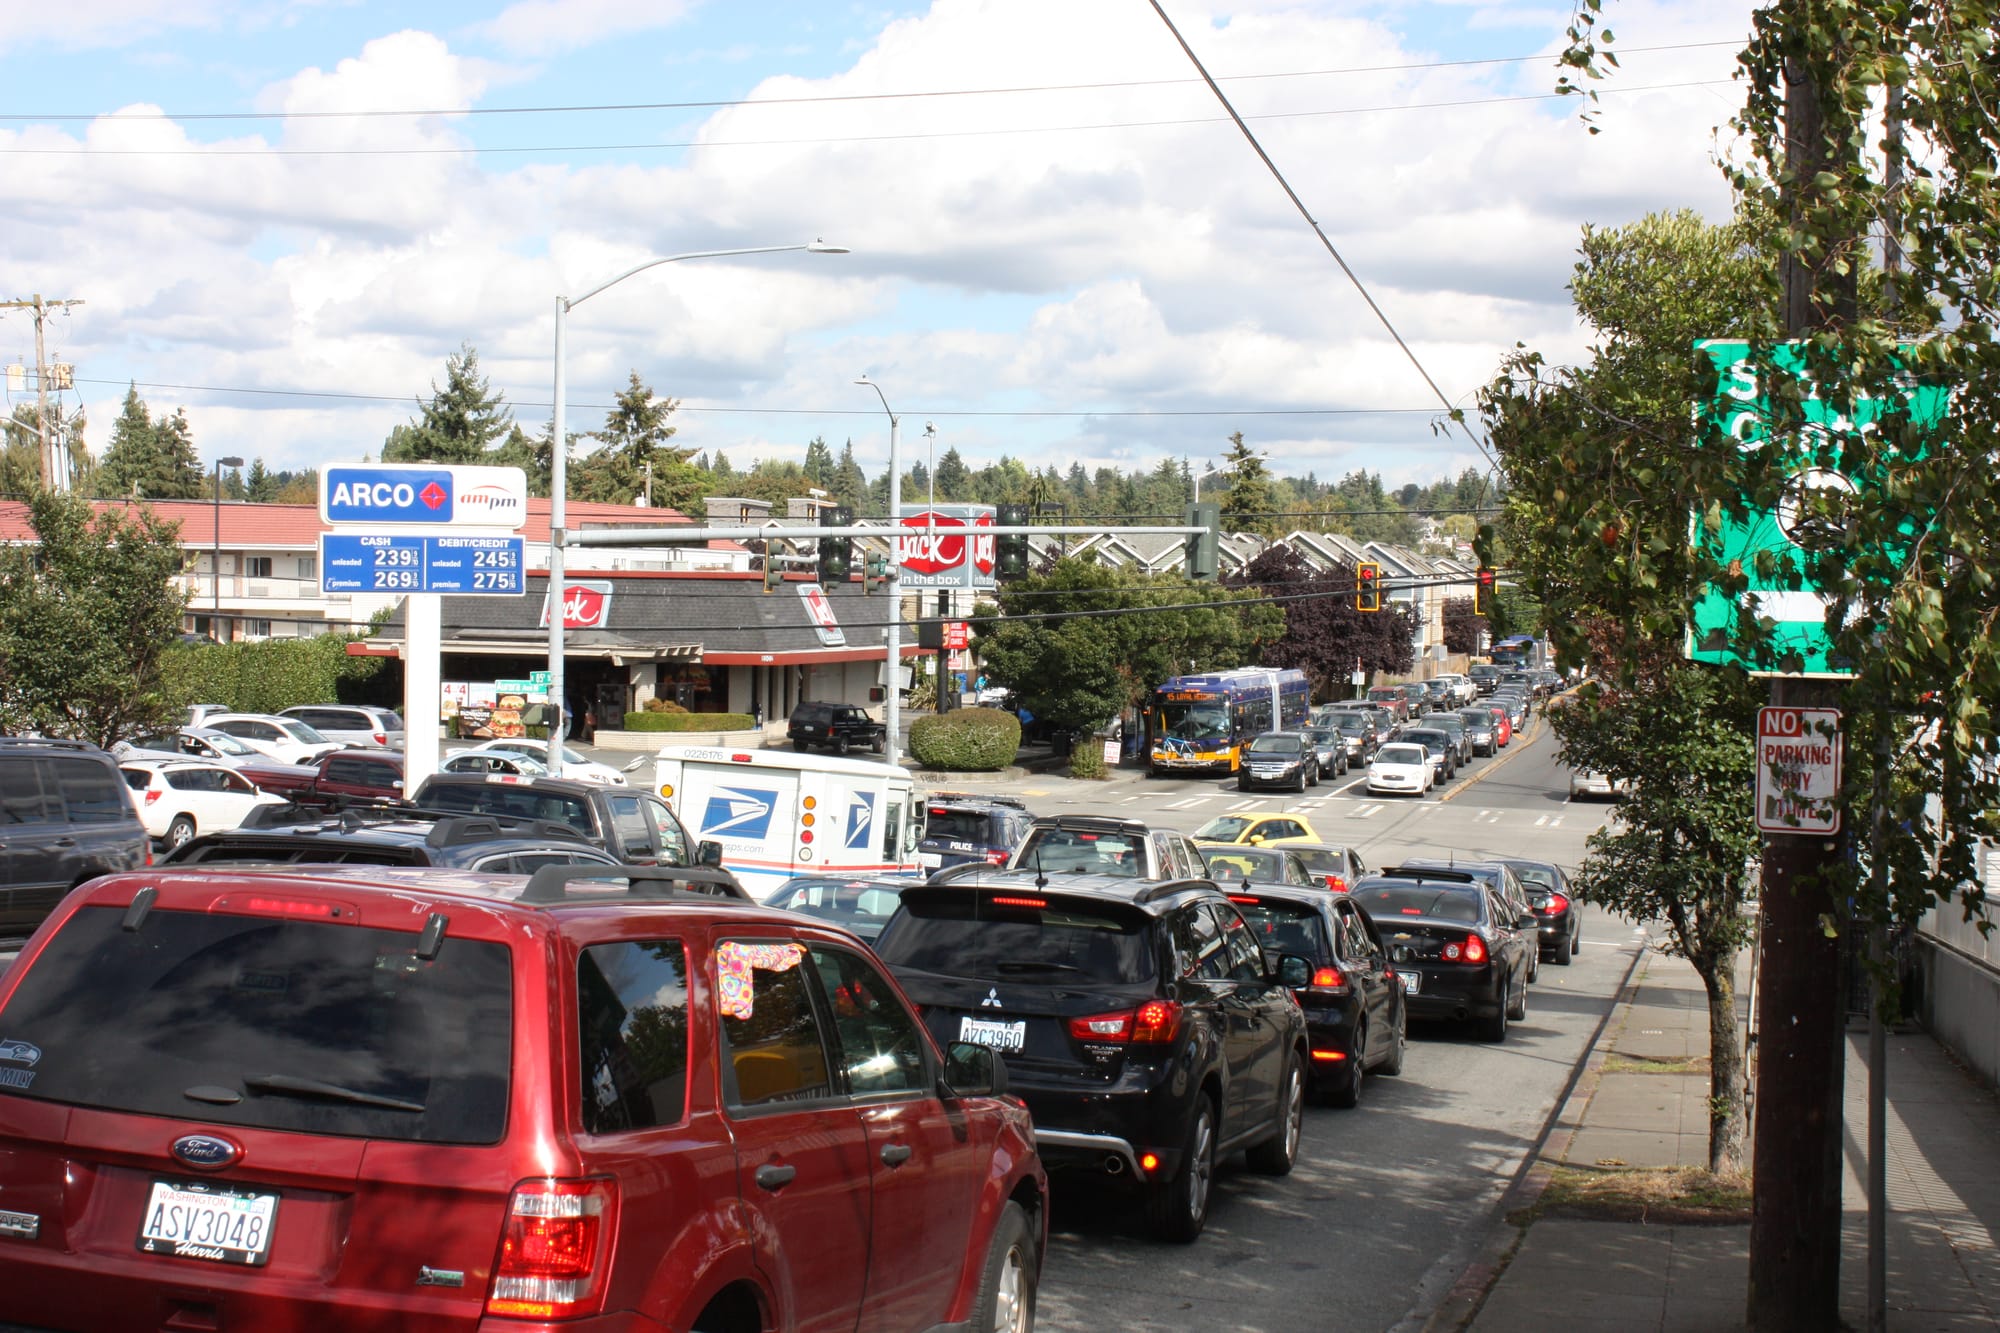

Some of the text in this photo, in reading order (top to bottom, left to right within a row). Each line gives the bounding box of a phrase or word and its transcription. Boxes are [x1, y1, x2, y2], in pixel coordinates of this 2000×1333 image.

[331, 482, 415, 508] ARCO
[460, 494, 517, 511] ampm
[360, 537, 391, 546] CASH
[438, 538, 510, 549] DEBIT/CREDIT
[332, 558, 362, 566] unleaded
[374, 549, 411, 566] 239
[432, 559, 462, 568] unleaded
[473, 551, 509, 567] 245
[332, 580, 362, 588] premium
[374, 571, 411, 587] 269
[432, 580, 461, 589] premium
[473, 573, 509, 588] 275
[900, 574, 961, 585] in the box
[1765, 711, 1797, 734] NO
[684, 749, 724, 760] 0226176
[1765, 744, 1831, 765] PARKING
[950, 841, 973, 851] POLICE
[962, 1027, 1022, 1049] AZC3960
[0, 1067, 36, 1088] MILY
[183, 1139, 218, 1158] Ford
[160, 1190, 228, 1207] WASHINGTON
[147, 1202, 263, 1249] ASV3048
[175, 1240, 225, 1260] Harris
